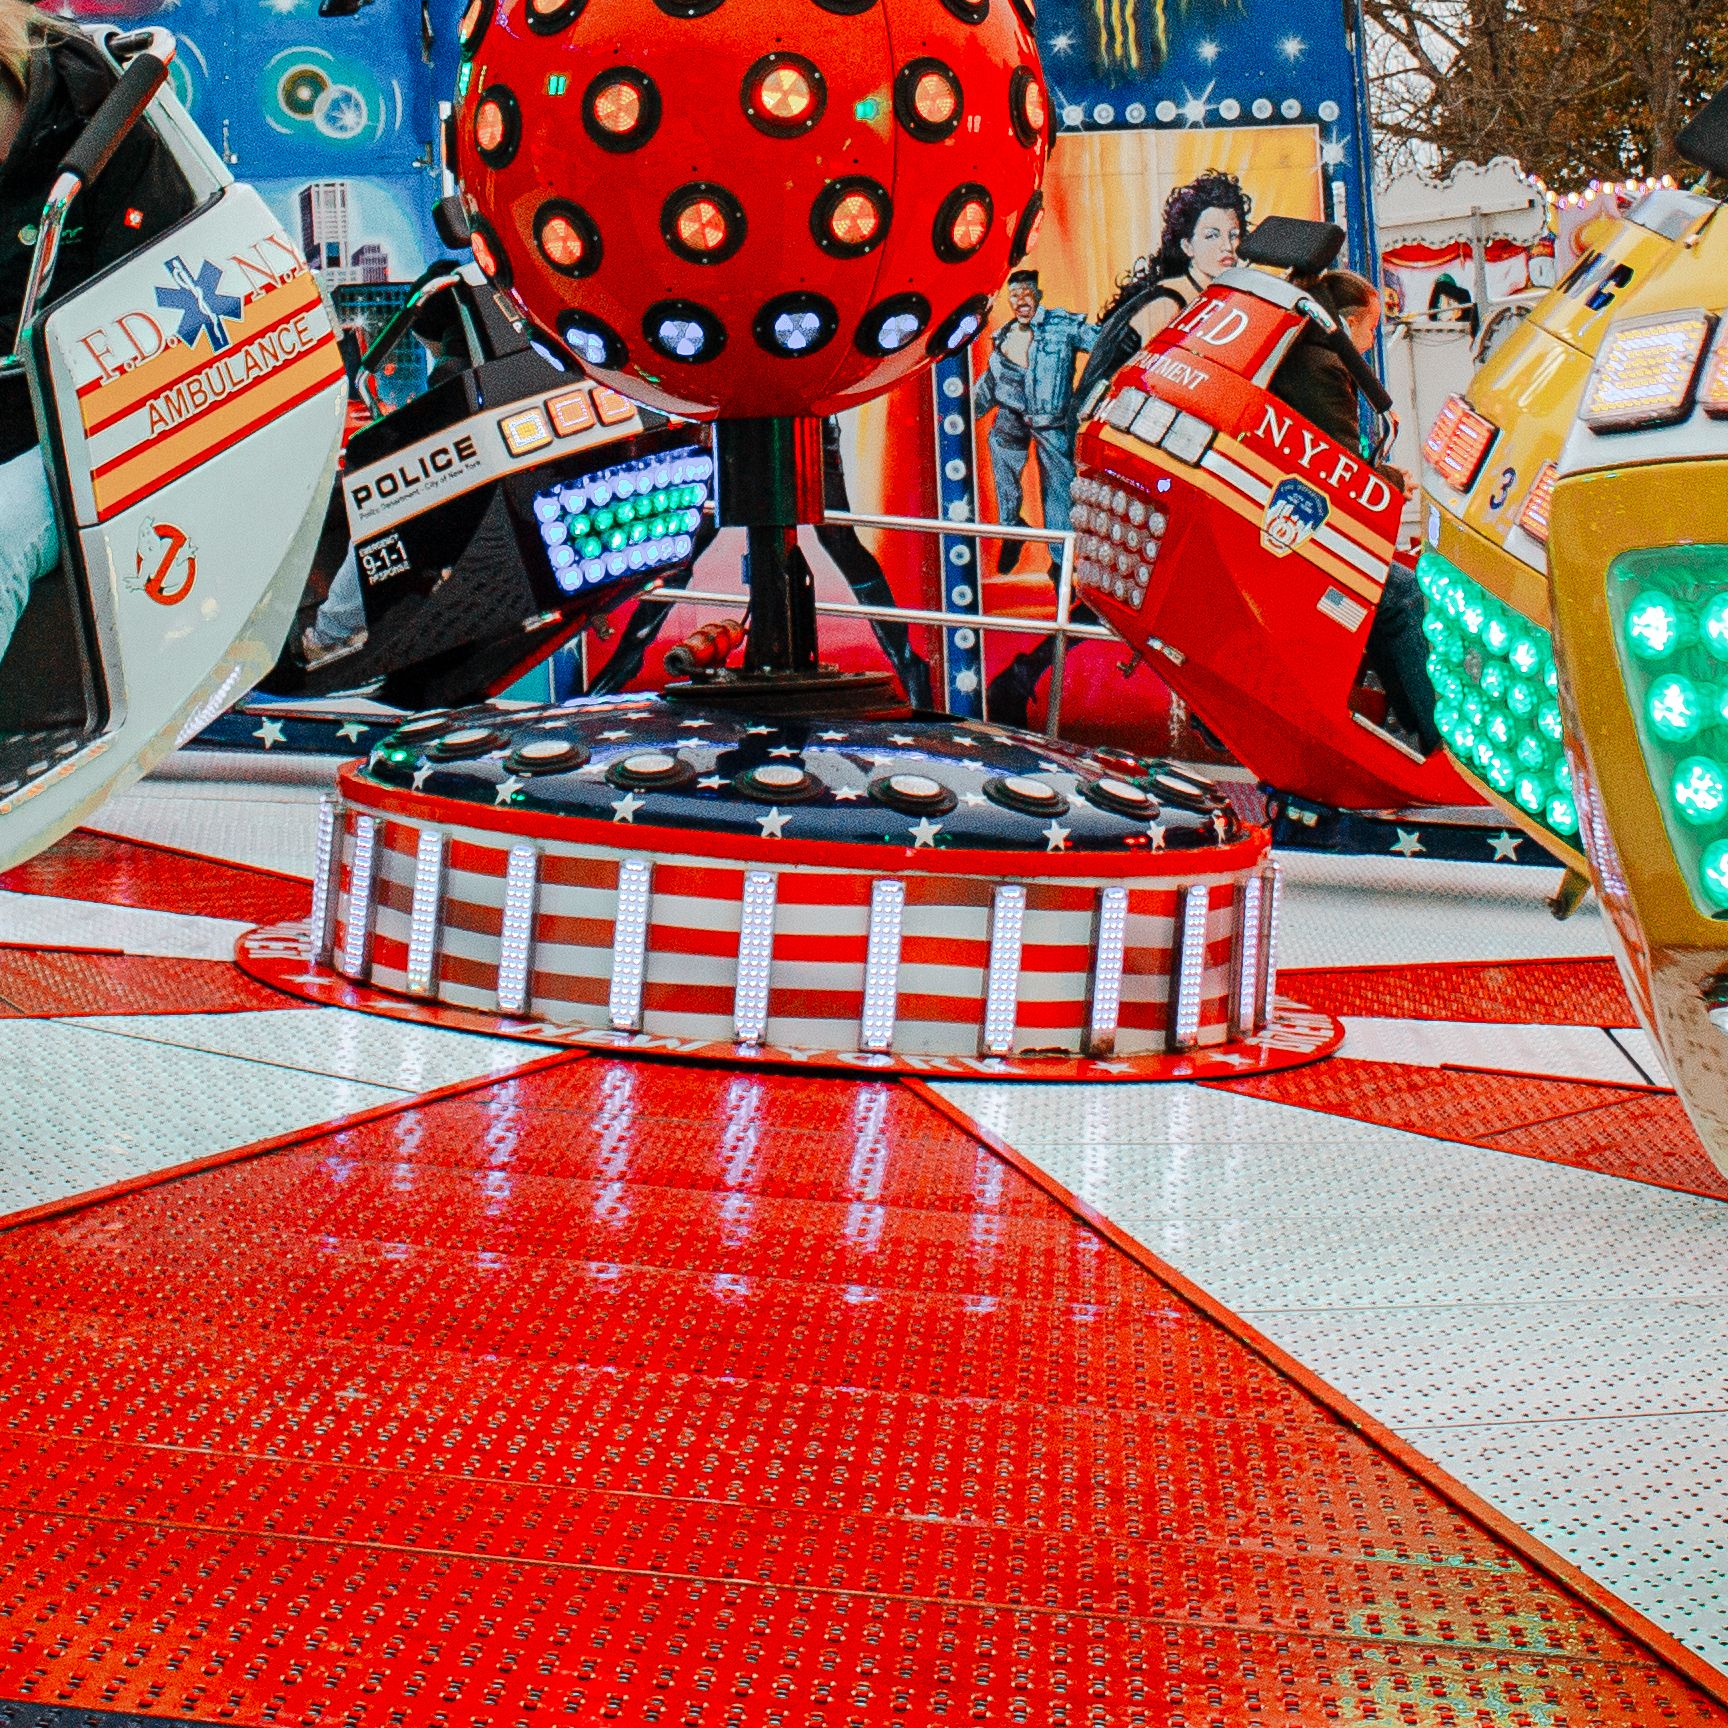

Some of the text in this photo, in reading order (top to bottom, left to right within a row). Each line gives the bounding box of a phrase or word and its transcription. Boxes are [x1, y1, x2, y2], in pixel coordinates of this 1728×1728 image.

[148, 315, 316, 436] AMBULANCE
[351, 433, 477, 511] POLICE
[1254, 403, 1391, 512] N.Y.F.D
[1489, 466, 1516, 510] 3
[362, 540, 408, 576] 9-1-1
